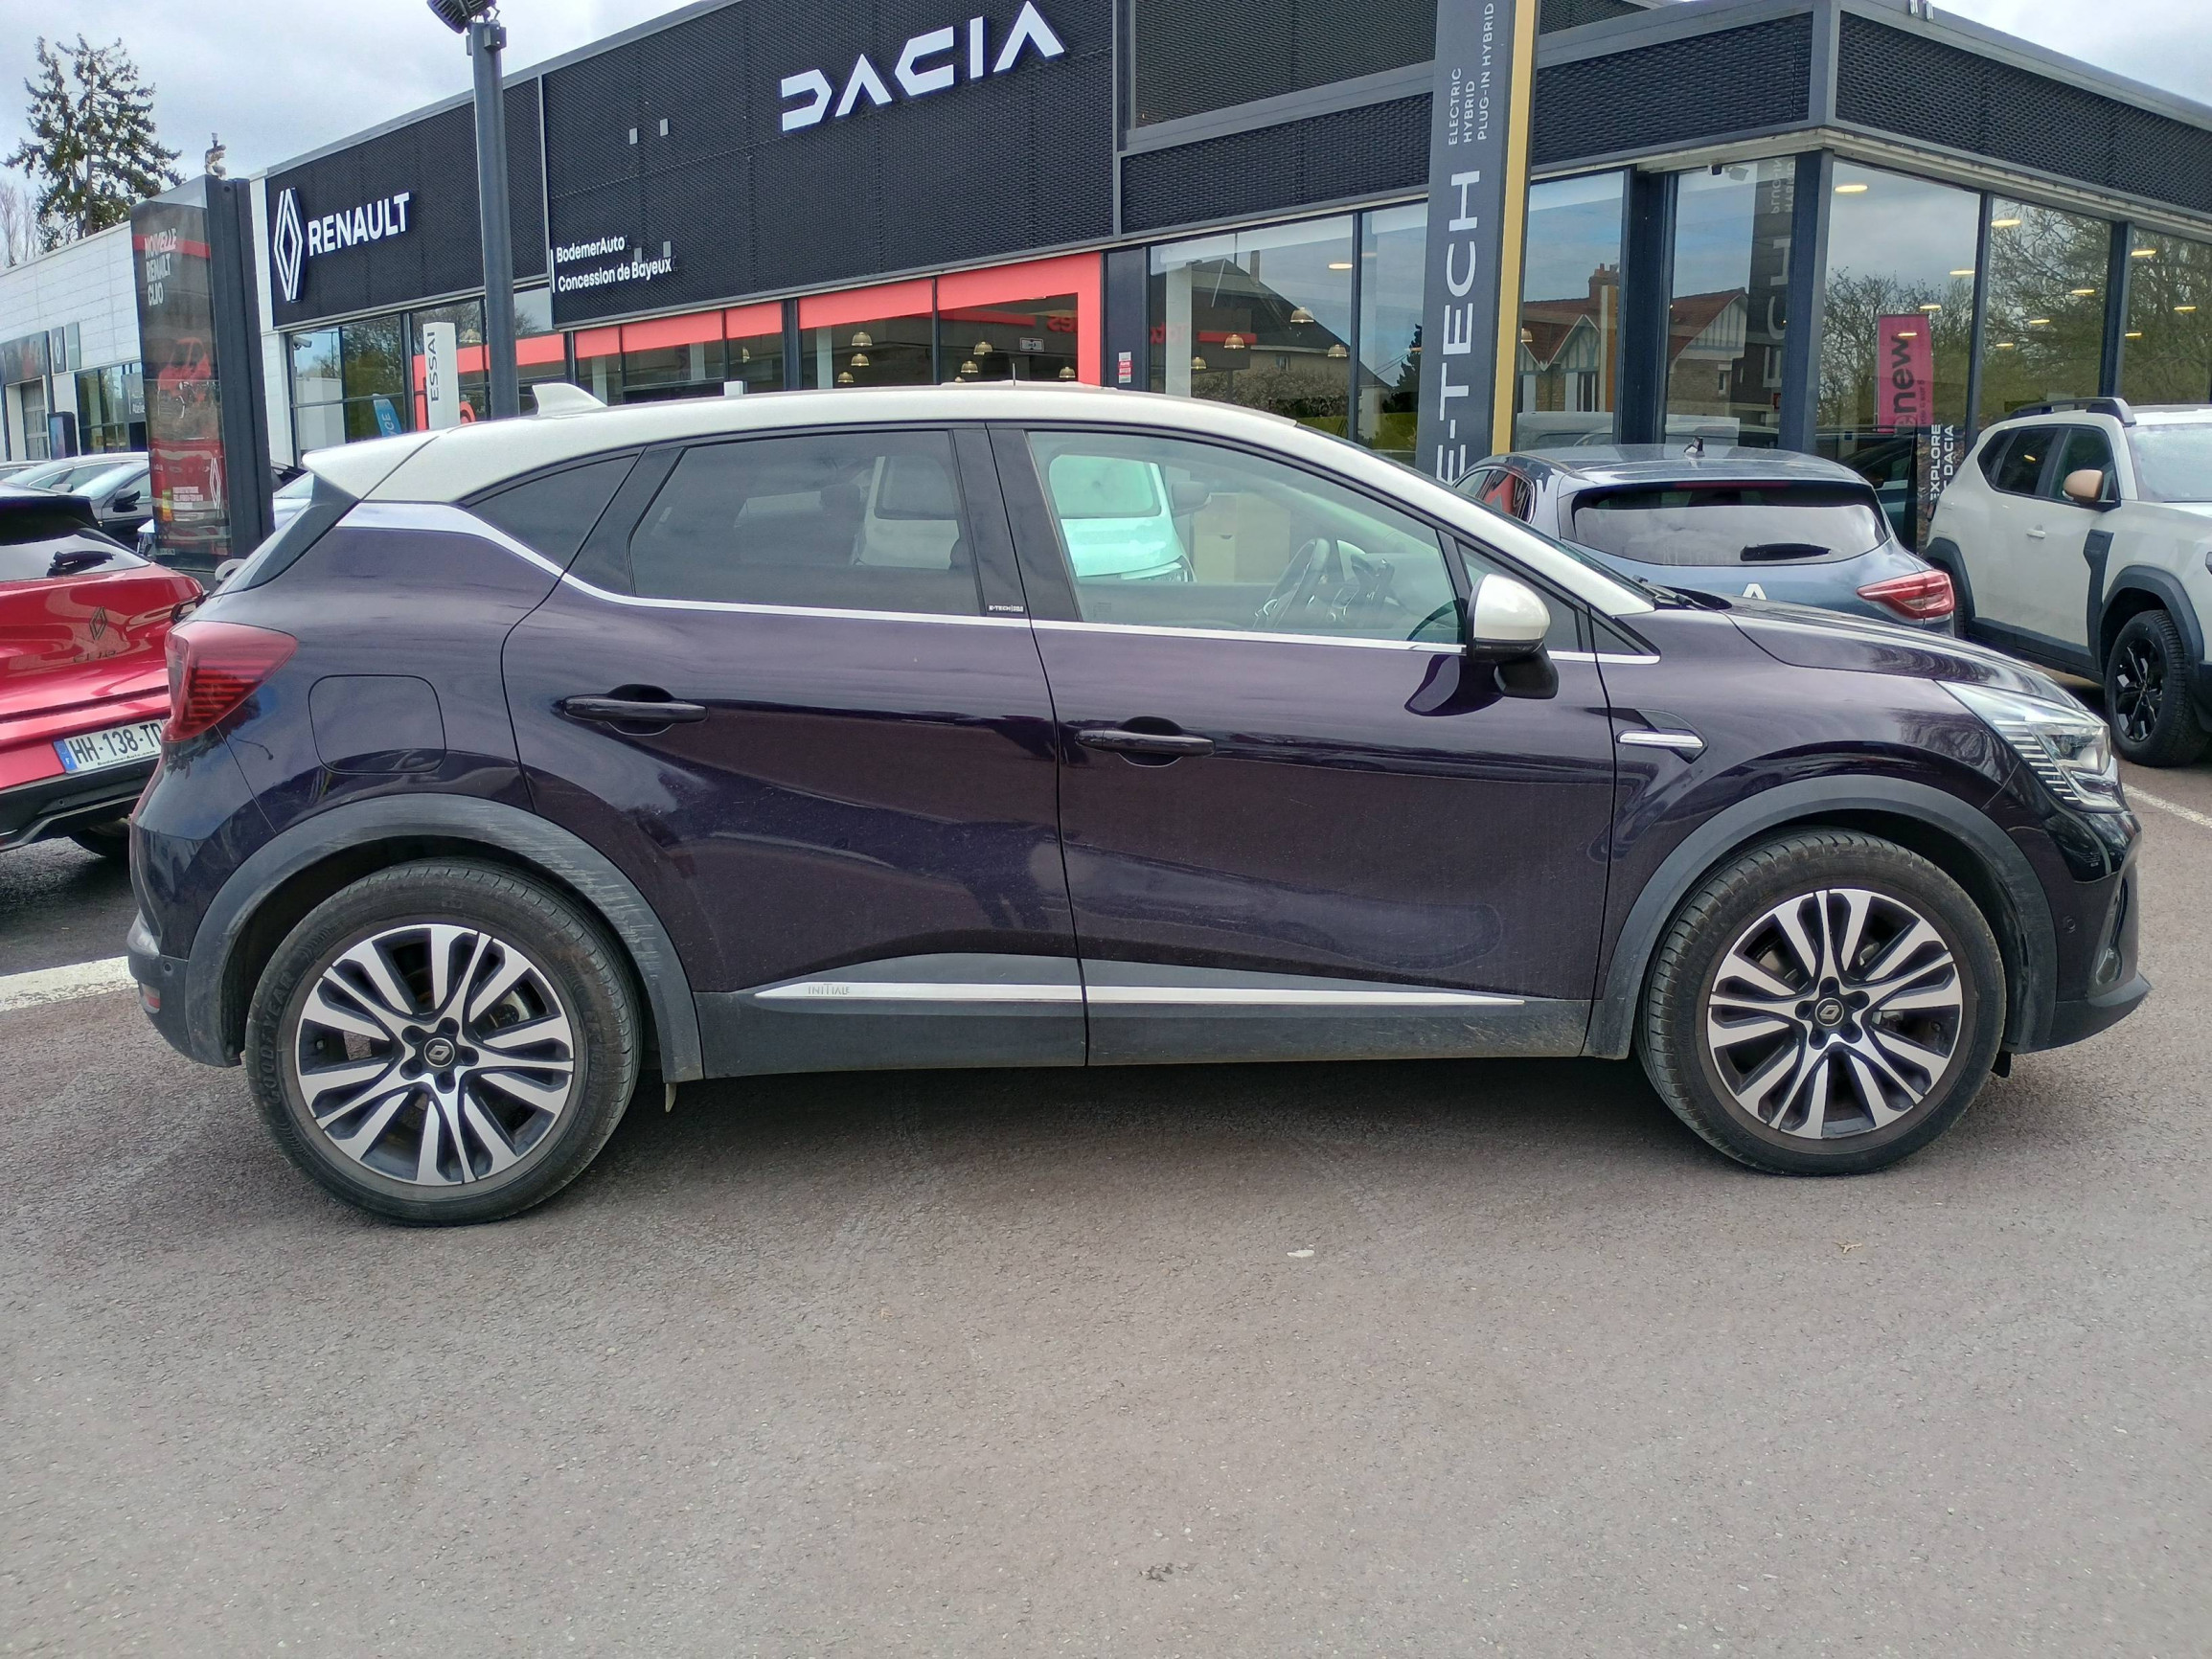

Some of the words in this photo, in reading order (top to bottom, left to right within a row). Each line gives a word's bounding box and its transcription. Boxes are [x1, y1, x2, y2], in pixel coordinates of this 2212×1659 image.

[781, 1, 1064, 131] DACIA
[1482, 3, 1494, 66] HYBRID
[1448, 68, 1462, 146] ELECTRIC
[1464, 80, 1475, 143] HYBRID
[1478, 71, 1491, 140] PLUG-IN
[308, 192, 410, 257] RENAULT
[557, 236, 626, 263] BodemerAuto
[148, 282, 164, 307] CLIO
[558, 267, 616, 292] Concession
[616, 262, 631, 282] de
[631, 257, 673, 281] Bayeux
[1437, 170, 1480, 485] E-TECH
[426, 331, 440, 402] ESSAI
[1929, 424, 1941, 501] EXPLORE
[1944, 424, 1954, 476] DACIA
[808, 983, 851, 996] INITIALE
